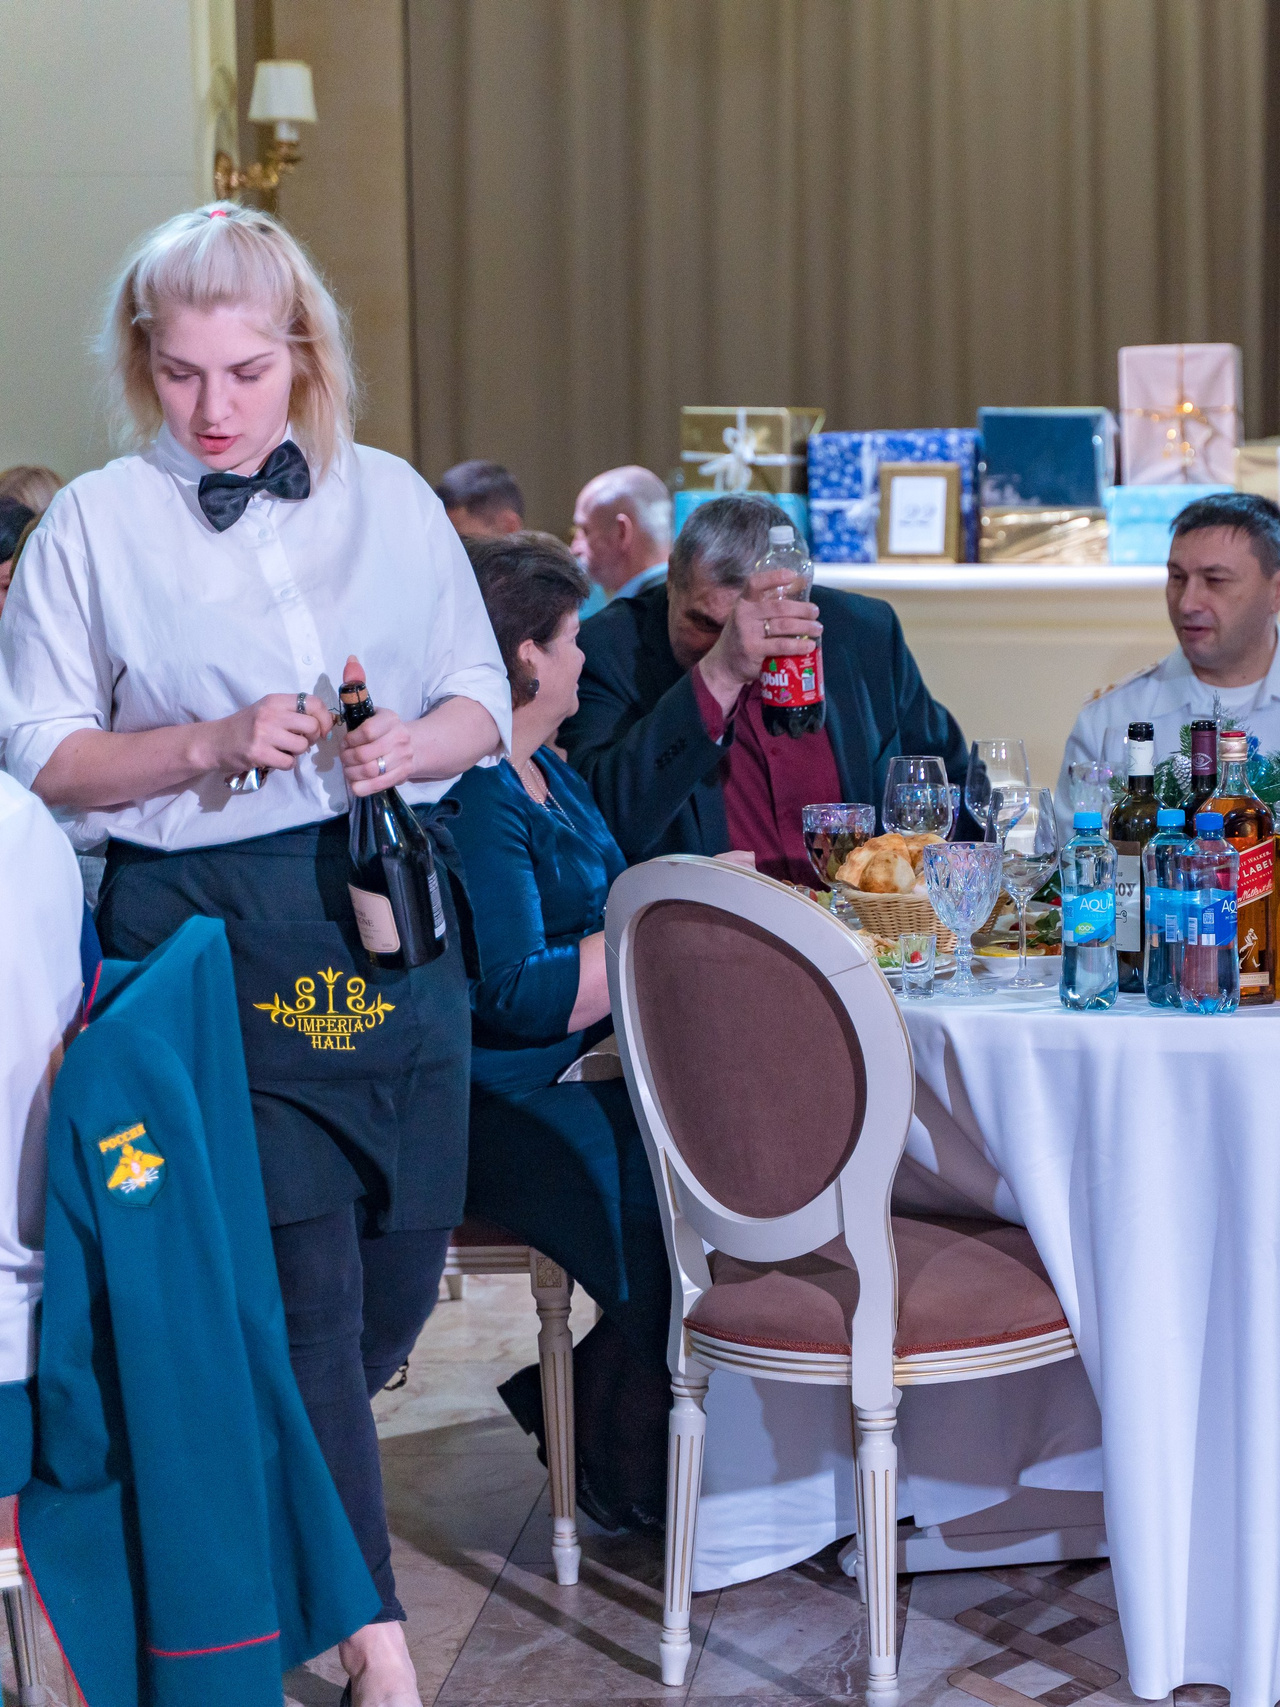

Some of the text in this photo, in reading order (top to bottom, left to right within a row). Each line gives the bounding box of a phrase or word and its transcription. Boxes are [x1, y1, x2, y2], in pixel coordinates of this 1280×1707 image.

[761, 669, 788, 687] рый
[1242, 858, 1273, 878] LABEL
[1079, 897, 1114, 913] AQUA
[1221, 899, 1238, 914] AQ
[297, 1018, 365, 1033] IMPERIA
[311, 1035, 356, 1050] HALL
[98, 1123, 147, 1153] РОССИЯ
